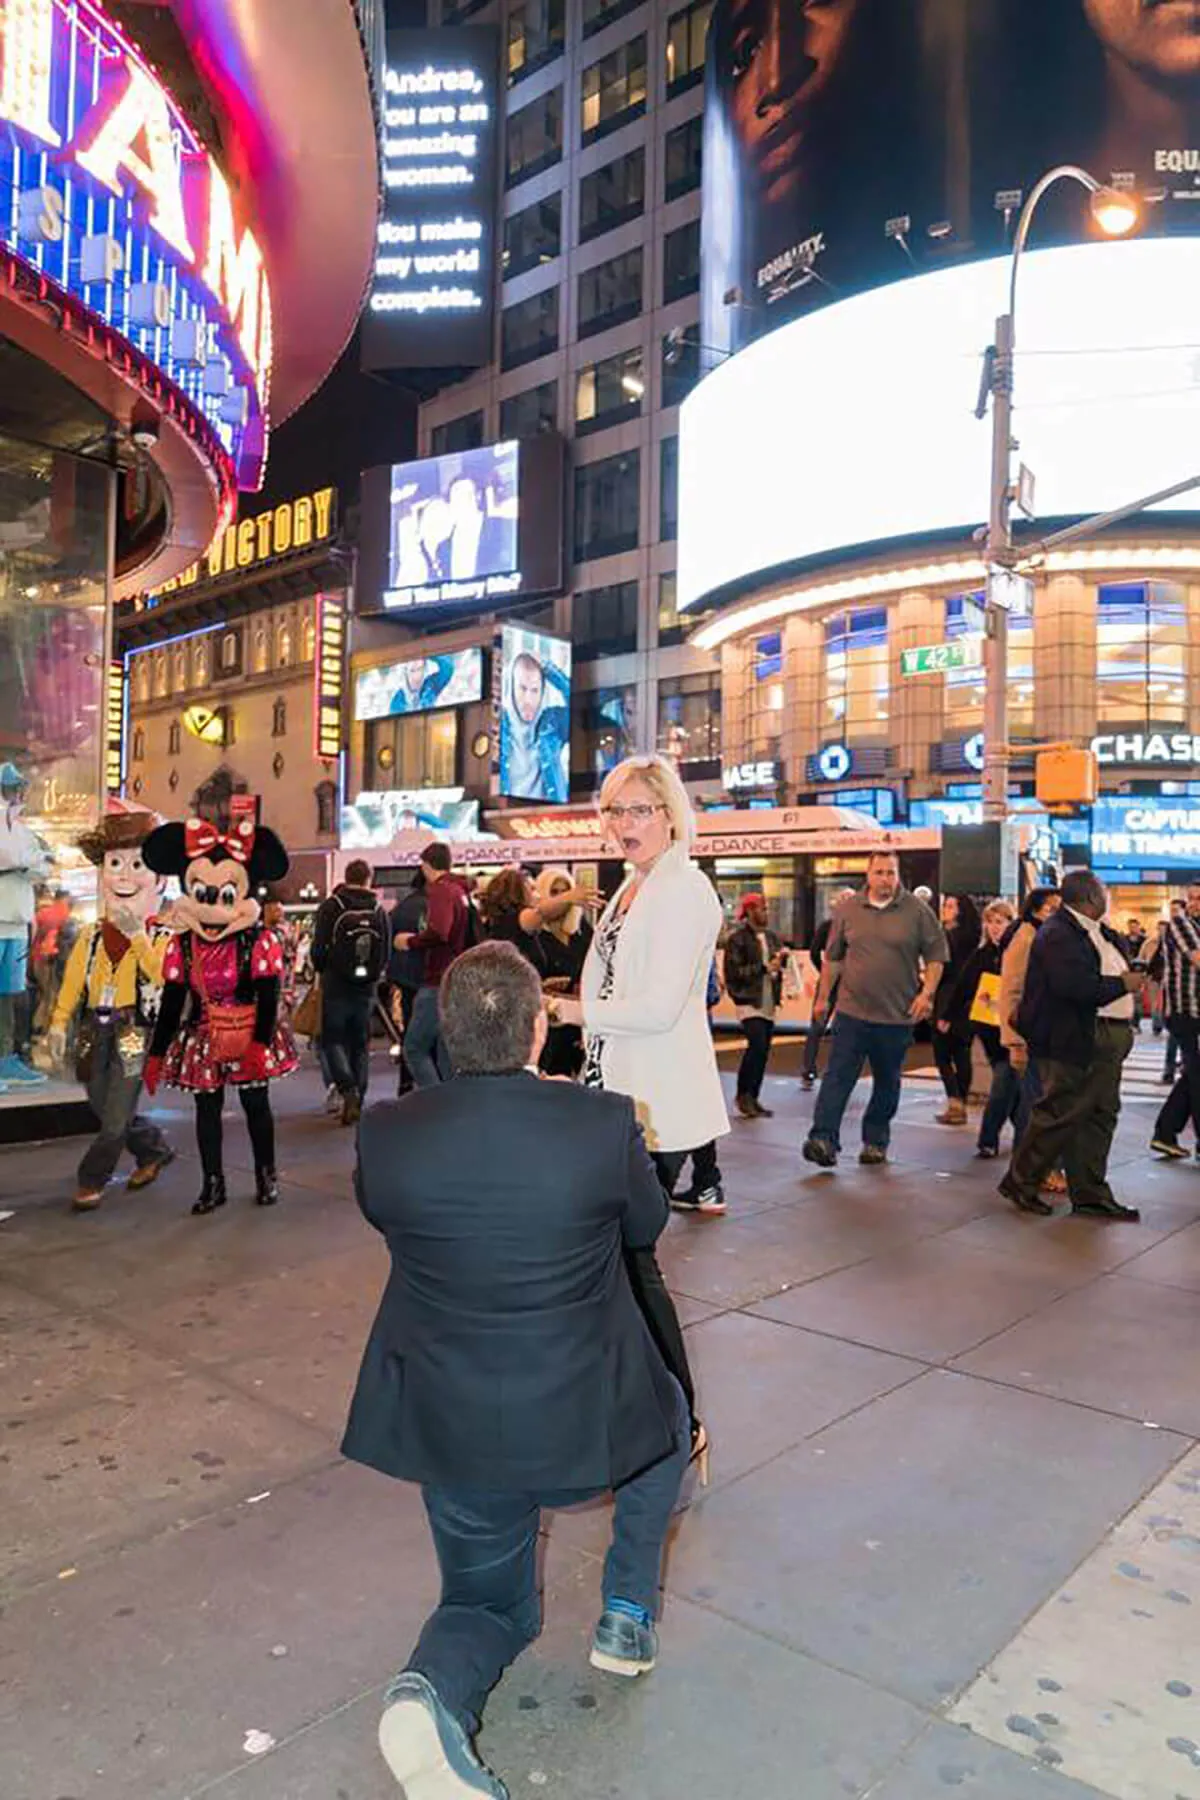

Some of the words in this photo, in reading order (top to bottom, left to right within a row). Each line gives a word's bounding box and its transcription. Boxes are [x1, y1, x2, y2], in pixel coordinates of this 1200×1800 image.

[384, 66, 483, 94] Andrea,
[384, 107, 416, 126] ou
[418, 106, 457, 123] are
[459, 103, 489, 122] an
[1155, 149, 1200, 172] EQU
[420, 215, 482, 241] make
[375, 256, 412, 279] my
[413, 248, 480, 274] world
[207, 487, 333, 577] VICTORY
[321, 600, 342, 697] VICTORY
[712, 837, 784, 851] DANCE
